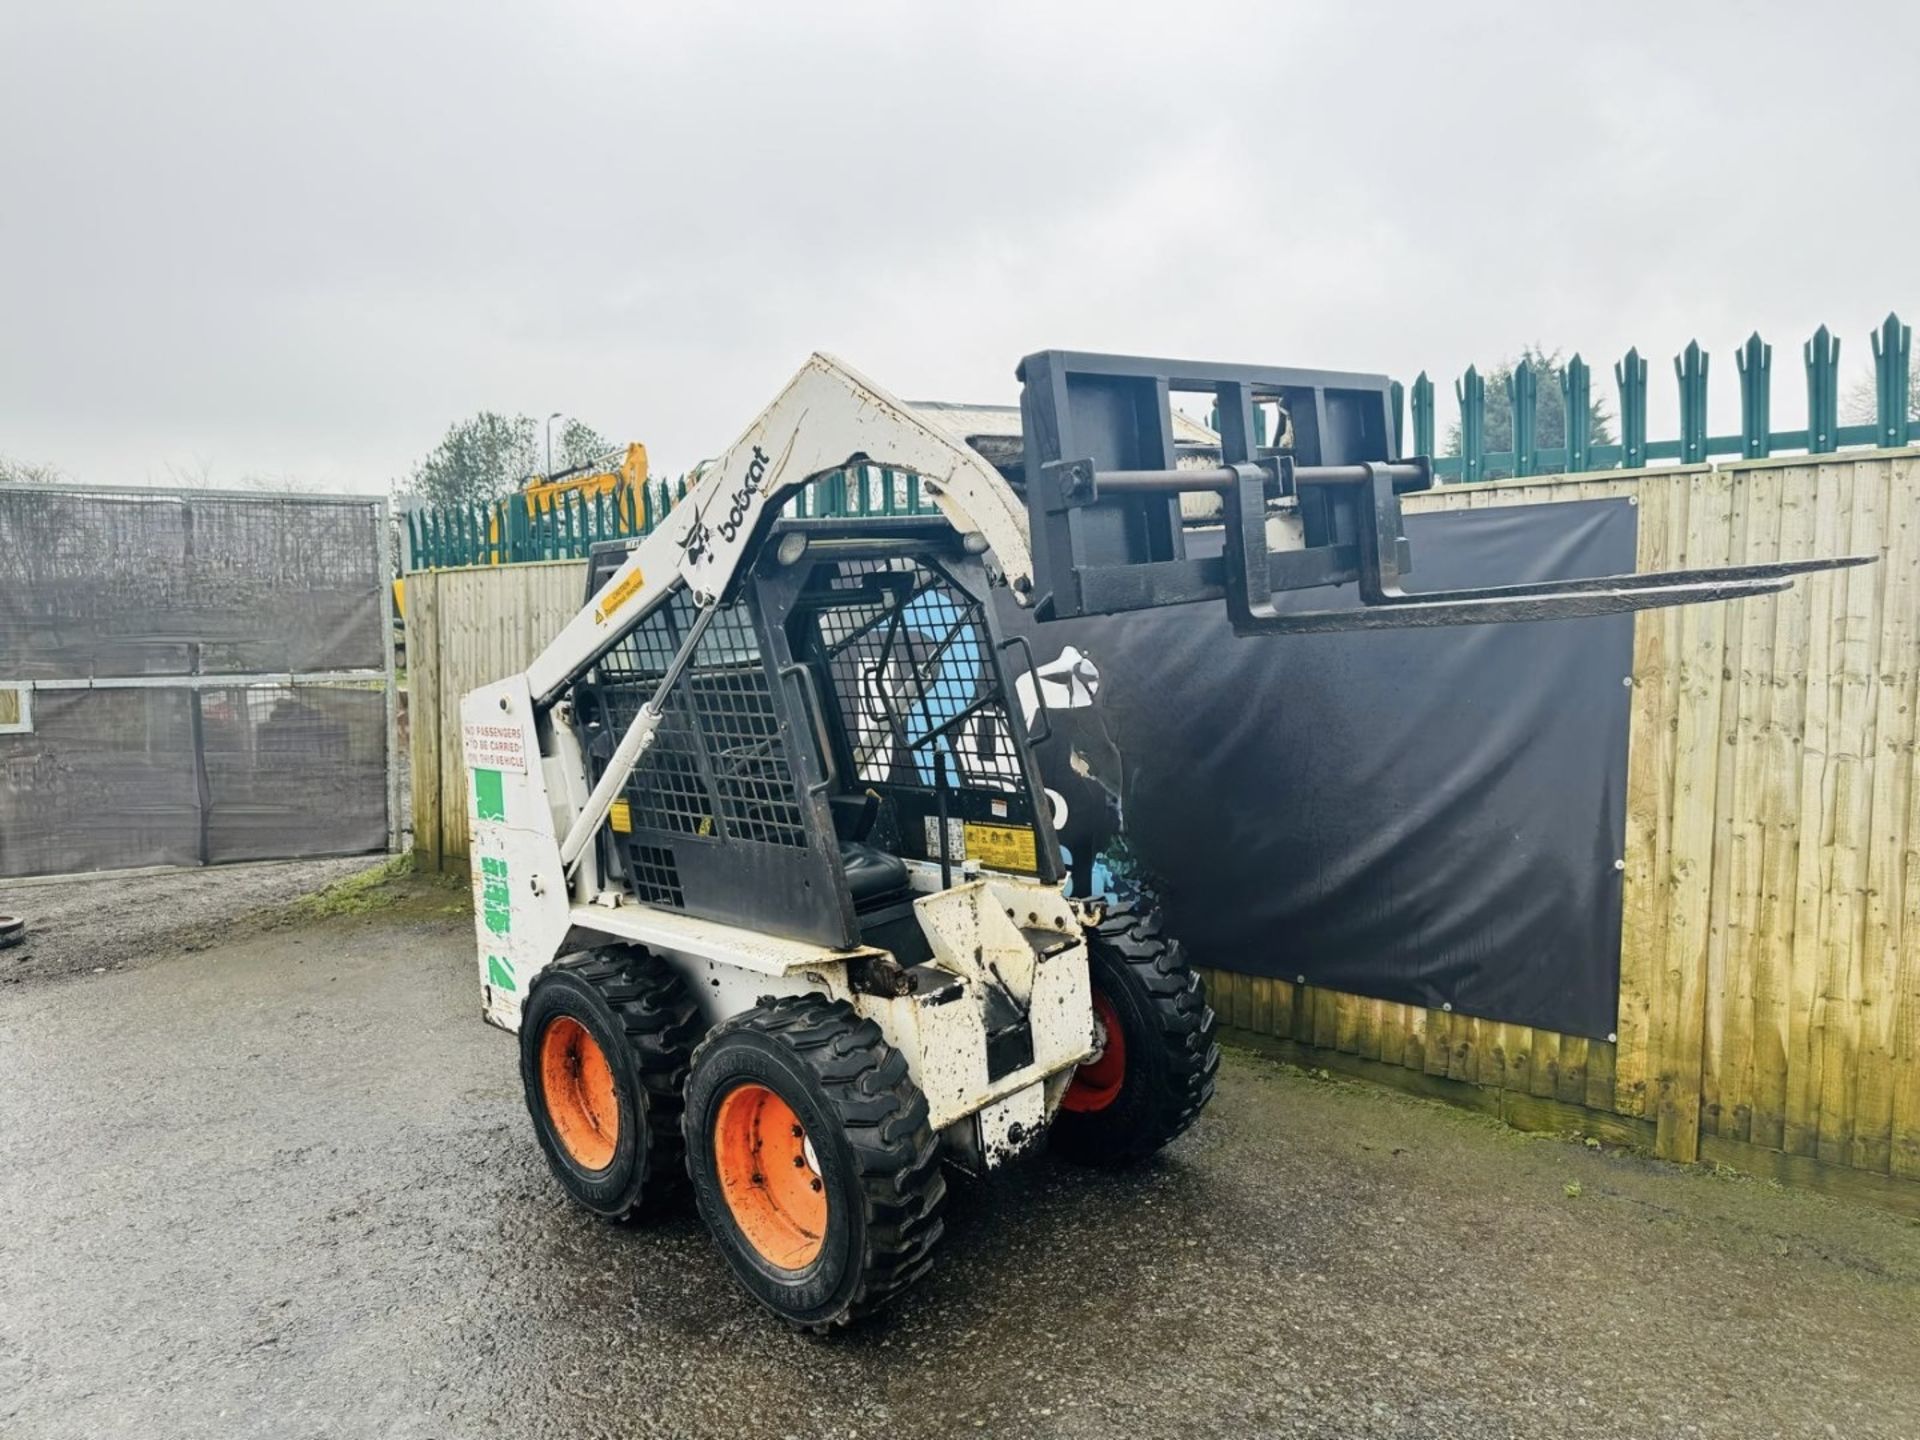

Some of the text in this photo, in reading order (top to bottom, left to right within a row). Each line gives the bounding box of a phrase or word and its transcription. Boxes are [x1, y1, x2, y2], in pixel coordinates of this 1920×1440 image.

[717, 445, 770, 543] bobcat
[465, 726, 521, 739] NO PASSENGERS
[480, 740, 488, 751] BE
[490, 741, 520, 752] CARRIED
[480, 754, 494, 765] THIS
[496, 755, 524, 767] VEHICLE
